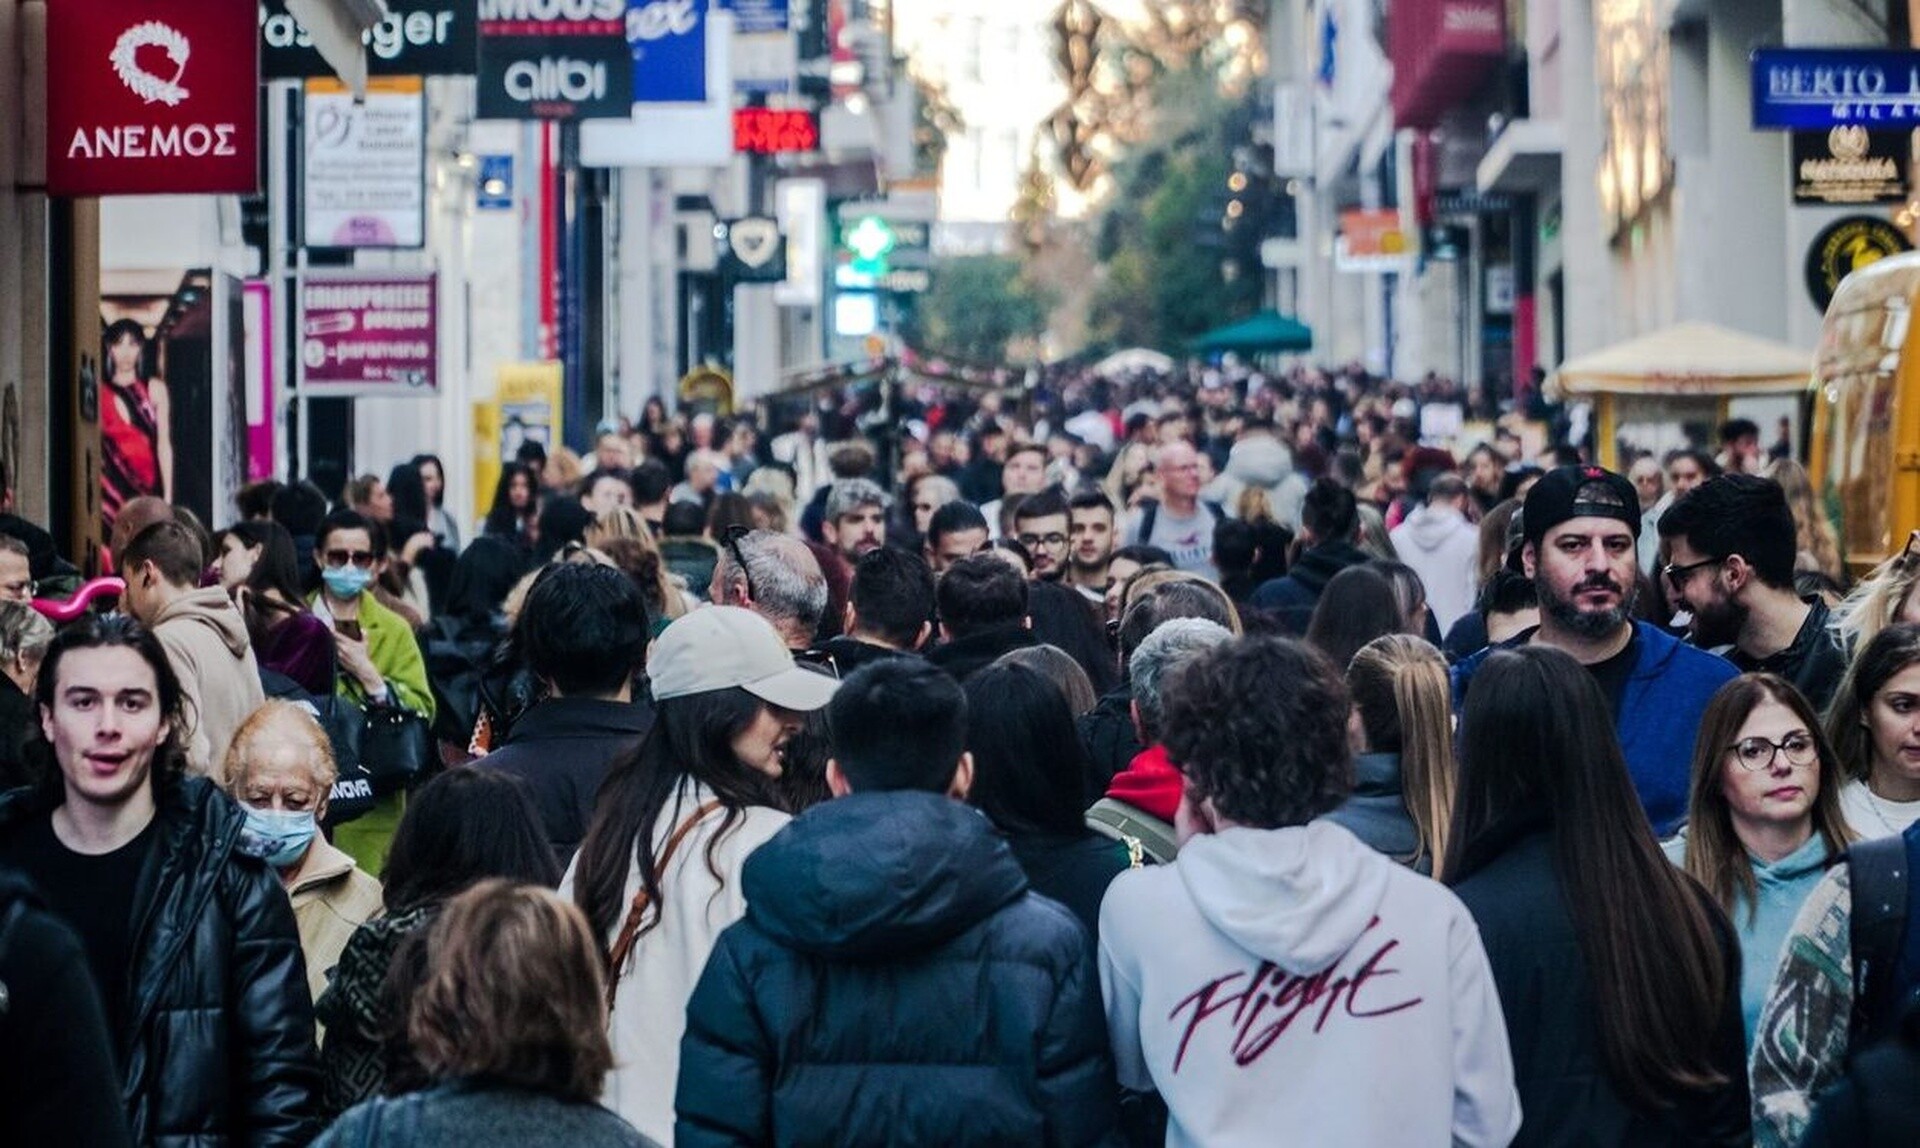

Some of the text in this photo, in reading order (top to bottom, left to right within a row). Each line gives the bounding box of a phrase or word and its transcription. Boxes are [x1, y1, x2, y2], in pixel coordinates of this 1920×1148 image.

[1769, 66, 1886, 96] BERTO
[67, 123, 236, 158] ΑΝΕΜΟΣ
[1169, 915, 1423, 1074] Flight
